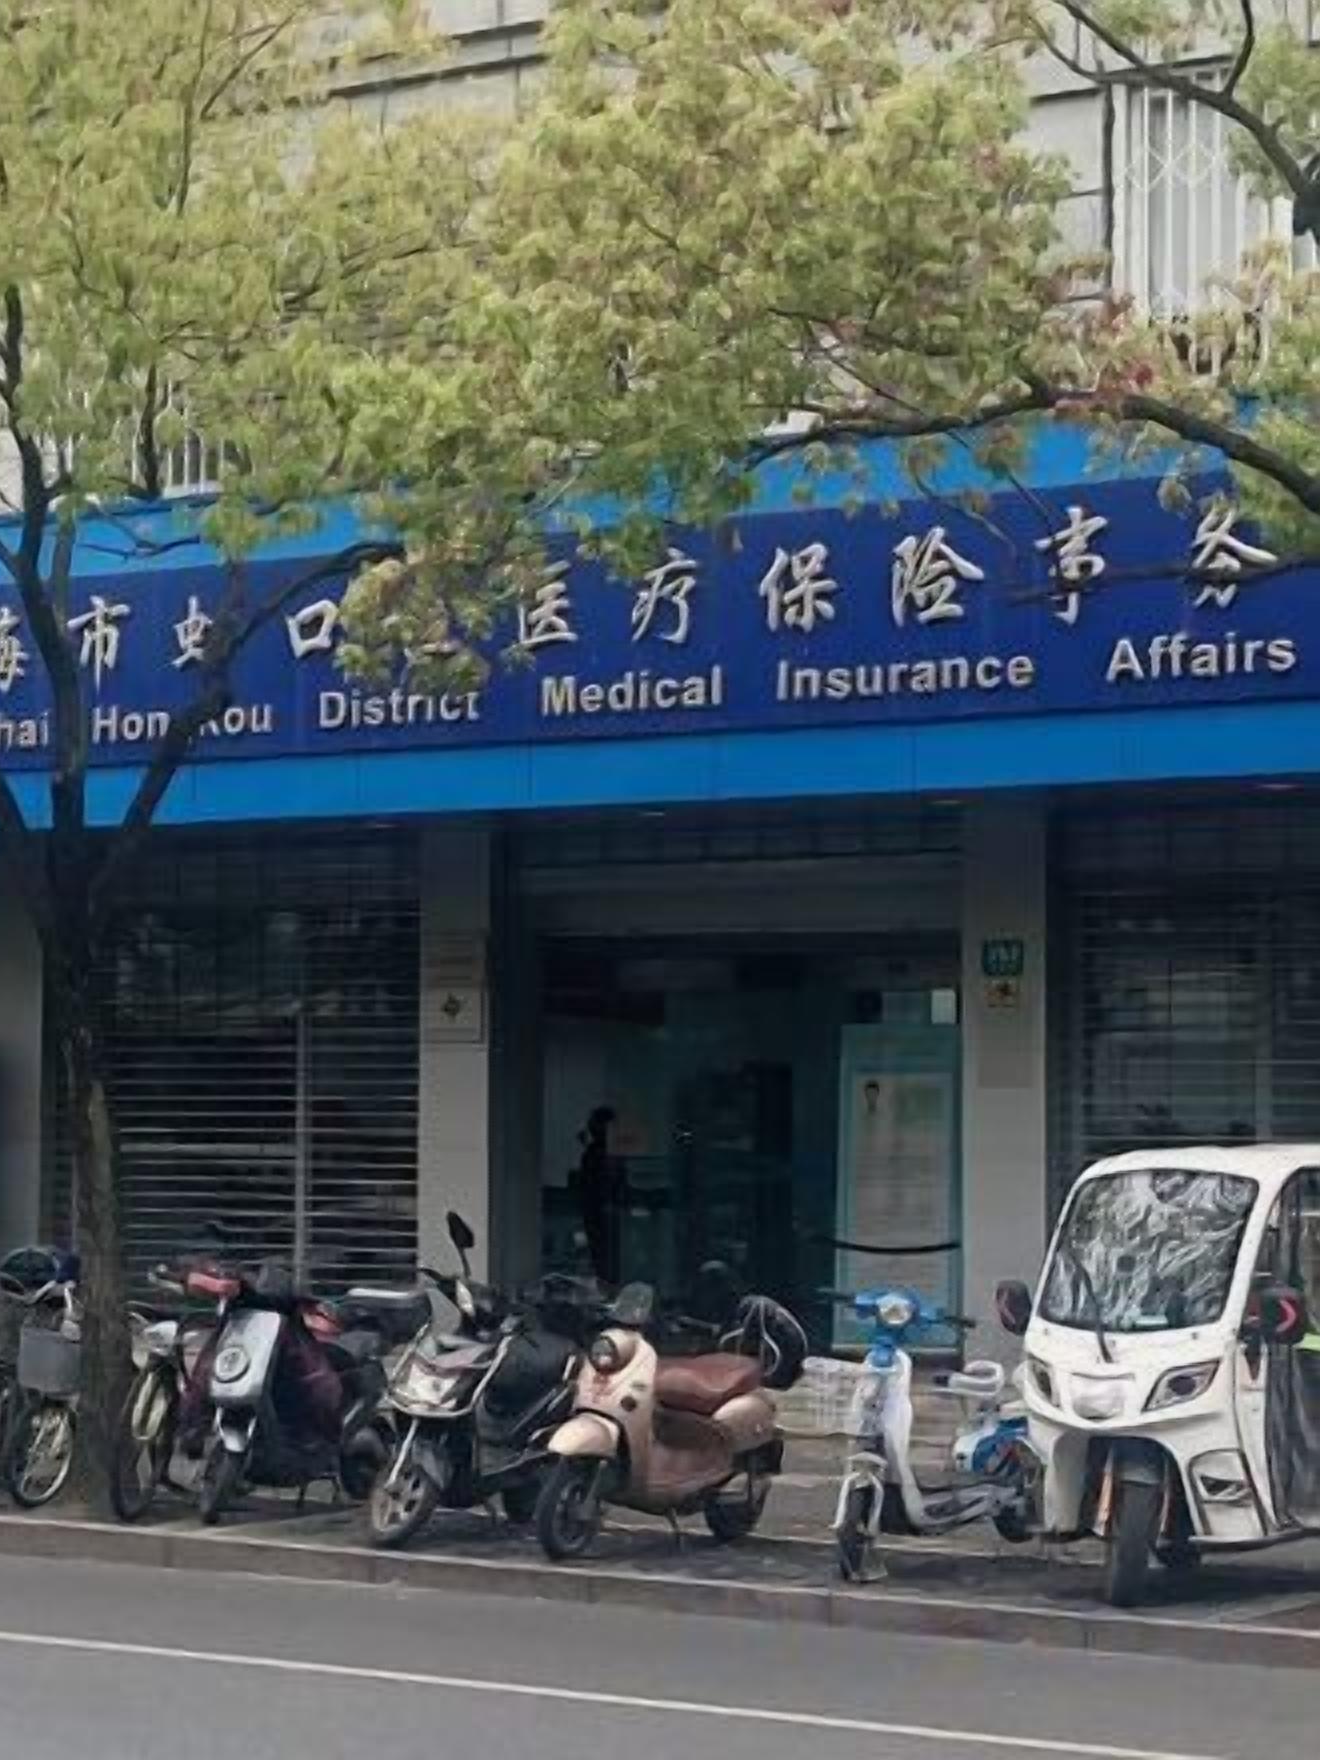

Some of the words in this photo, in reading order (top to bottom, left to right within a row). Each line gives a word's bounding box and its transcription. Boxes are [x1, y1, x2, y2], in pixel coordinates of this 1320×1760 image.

[92, 703, 272, 746] Honou
[319, 687, 480, 729] District
[541, 664, 722, 717] Medical
[776, 653, 1035, 701] Insurance
[1105, 631, 1297, 683] Affairs
